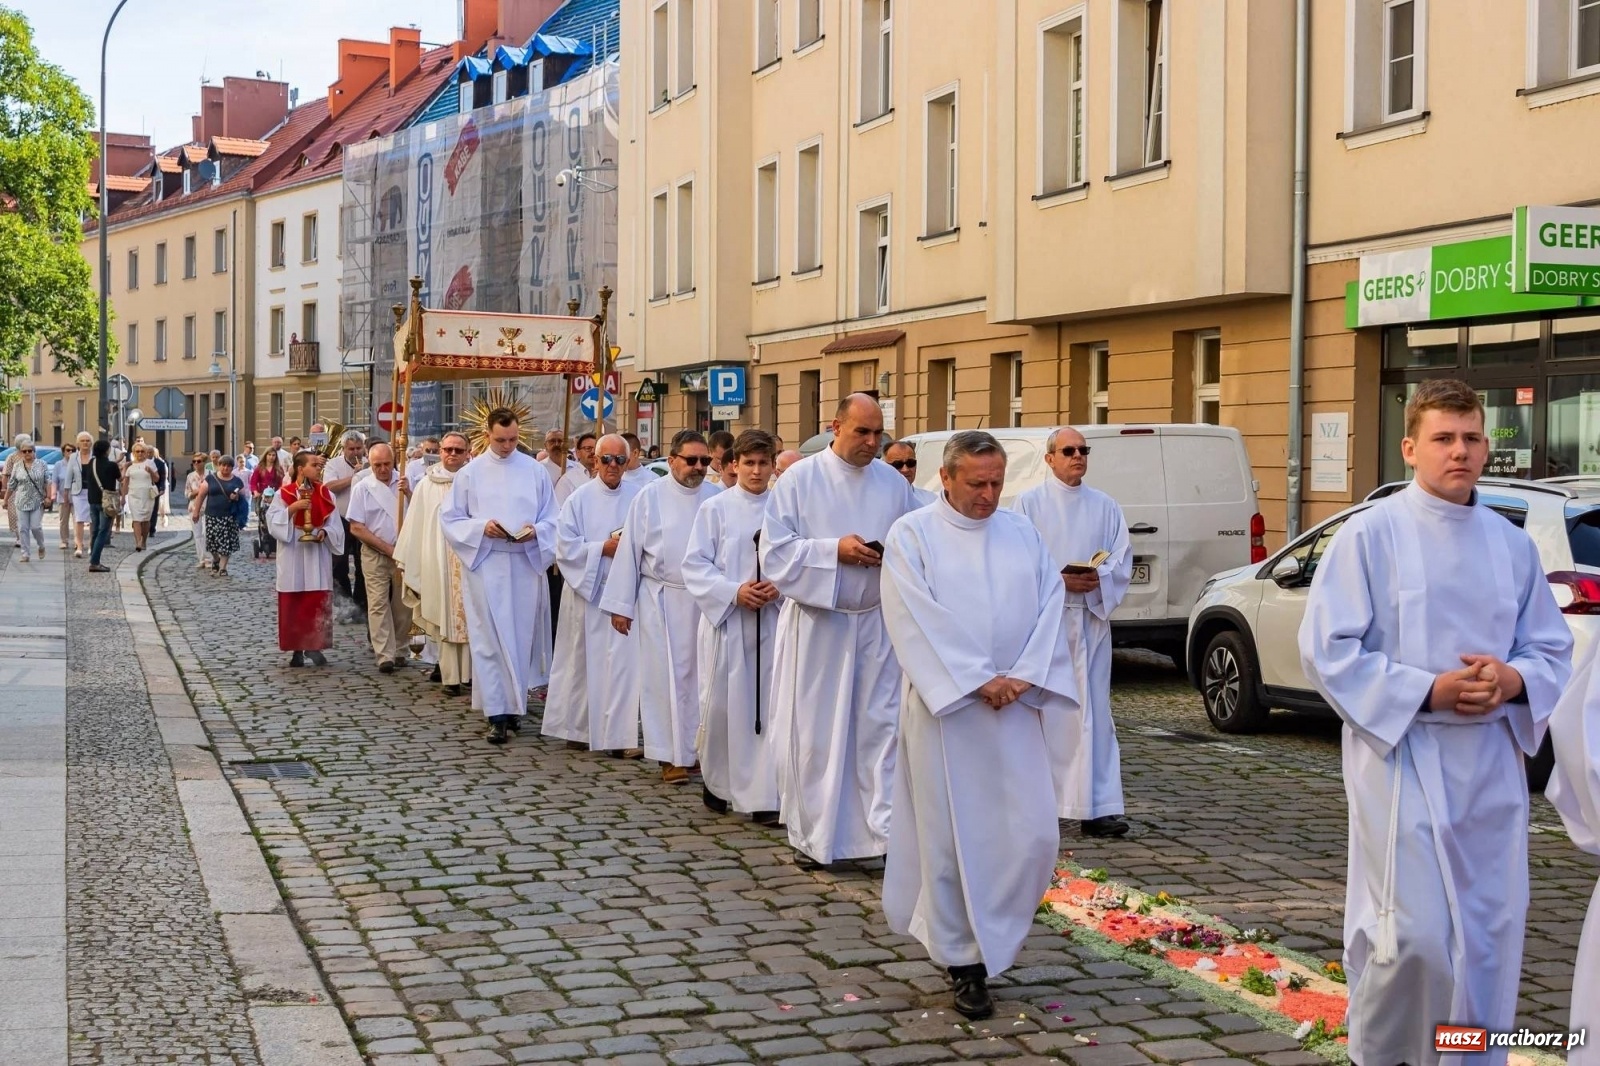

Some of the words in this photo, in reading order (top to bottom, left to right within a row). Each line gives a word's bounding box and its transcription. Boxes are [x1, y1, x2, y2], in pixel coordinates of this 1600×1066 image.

[418, 154, 432, 308] RIGO
[1539, 222, 1600, 249] GEER
[1363, 273, 1414, 302] GEERS
[1435, 262, 1501, 295] DOBRY
[1533, 270, 1589, 287] DOBRY
[1592, 272, 1600, 288] S
[574, 375, 616, 391] OKA
[718, 372, 738, 401] P
[1490, 428, 1514, 438] GEERS
